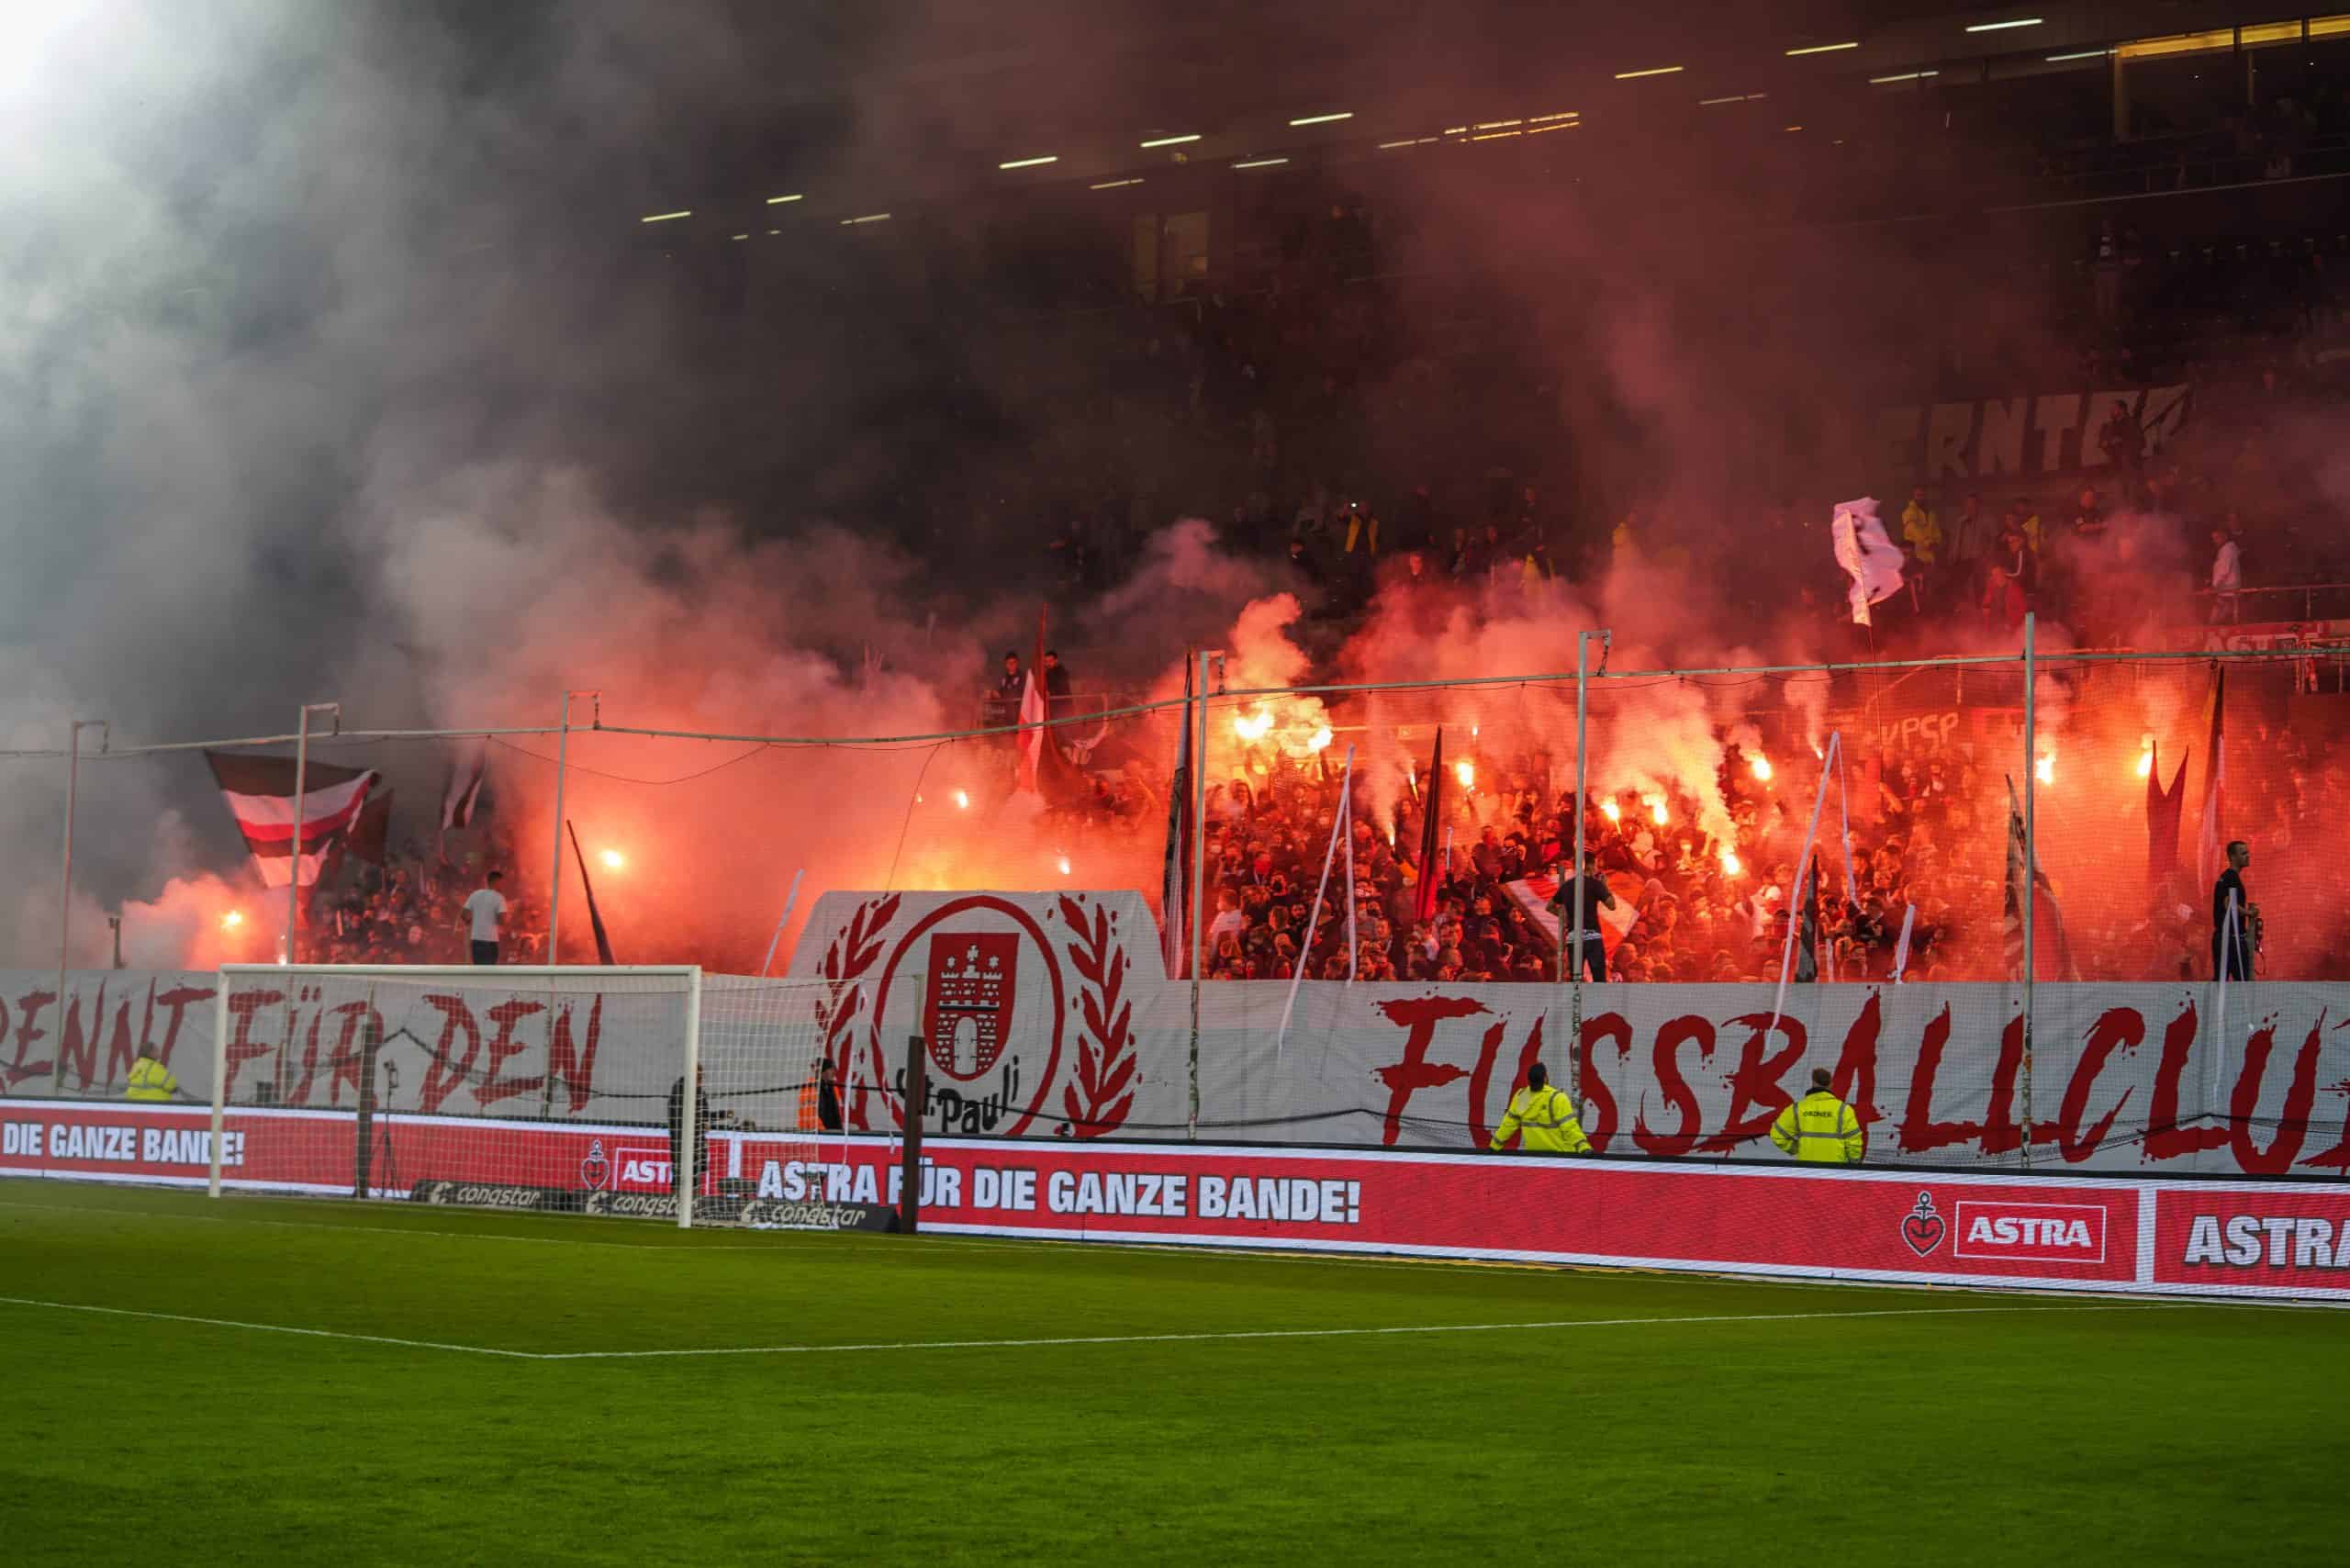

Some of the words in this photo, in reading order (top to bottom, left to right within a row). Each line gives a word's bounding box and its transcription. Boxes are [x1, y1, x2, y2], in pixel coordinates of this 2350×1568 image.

[0, 977, 218, 1097] ENNT
[223, 985, 384, 1109] FÜR
[420, 991, 602, 1114] DEN
[1374, 986, 2350, 1175] FUSSBALLCLU
[936, 1056, 1019, 1134] Pauli
[3, 1122, 43, 1155] DIE
[49, 1124, 136, 1160] GANZE
[622, 1159, 674, 1183] AST
[457, 1186, 541, 1207] congstar
[614, 1194, 698, 1217] congst
[758, 1160, 878, 1204] ASTRA
[972, 1169, 1037, 1210] DIE
[1047, 1172, 1187, 1216] GANZE
[1197, 1176, 1360, 1223] BANDE!
[771, 1204, 867, 1227] congstar
[1967, 1215, 2091, 1249] ASTRA
